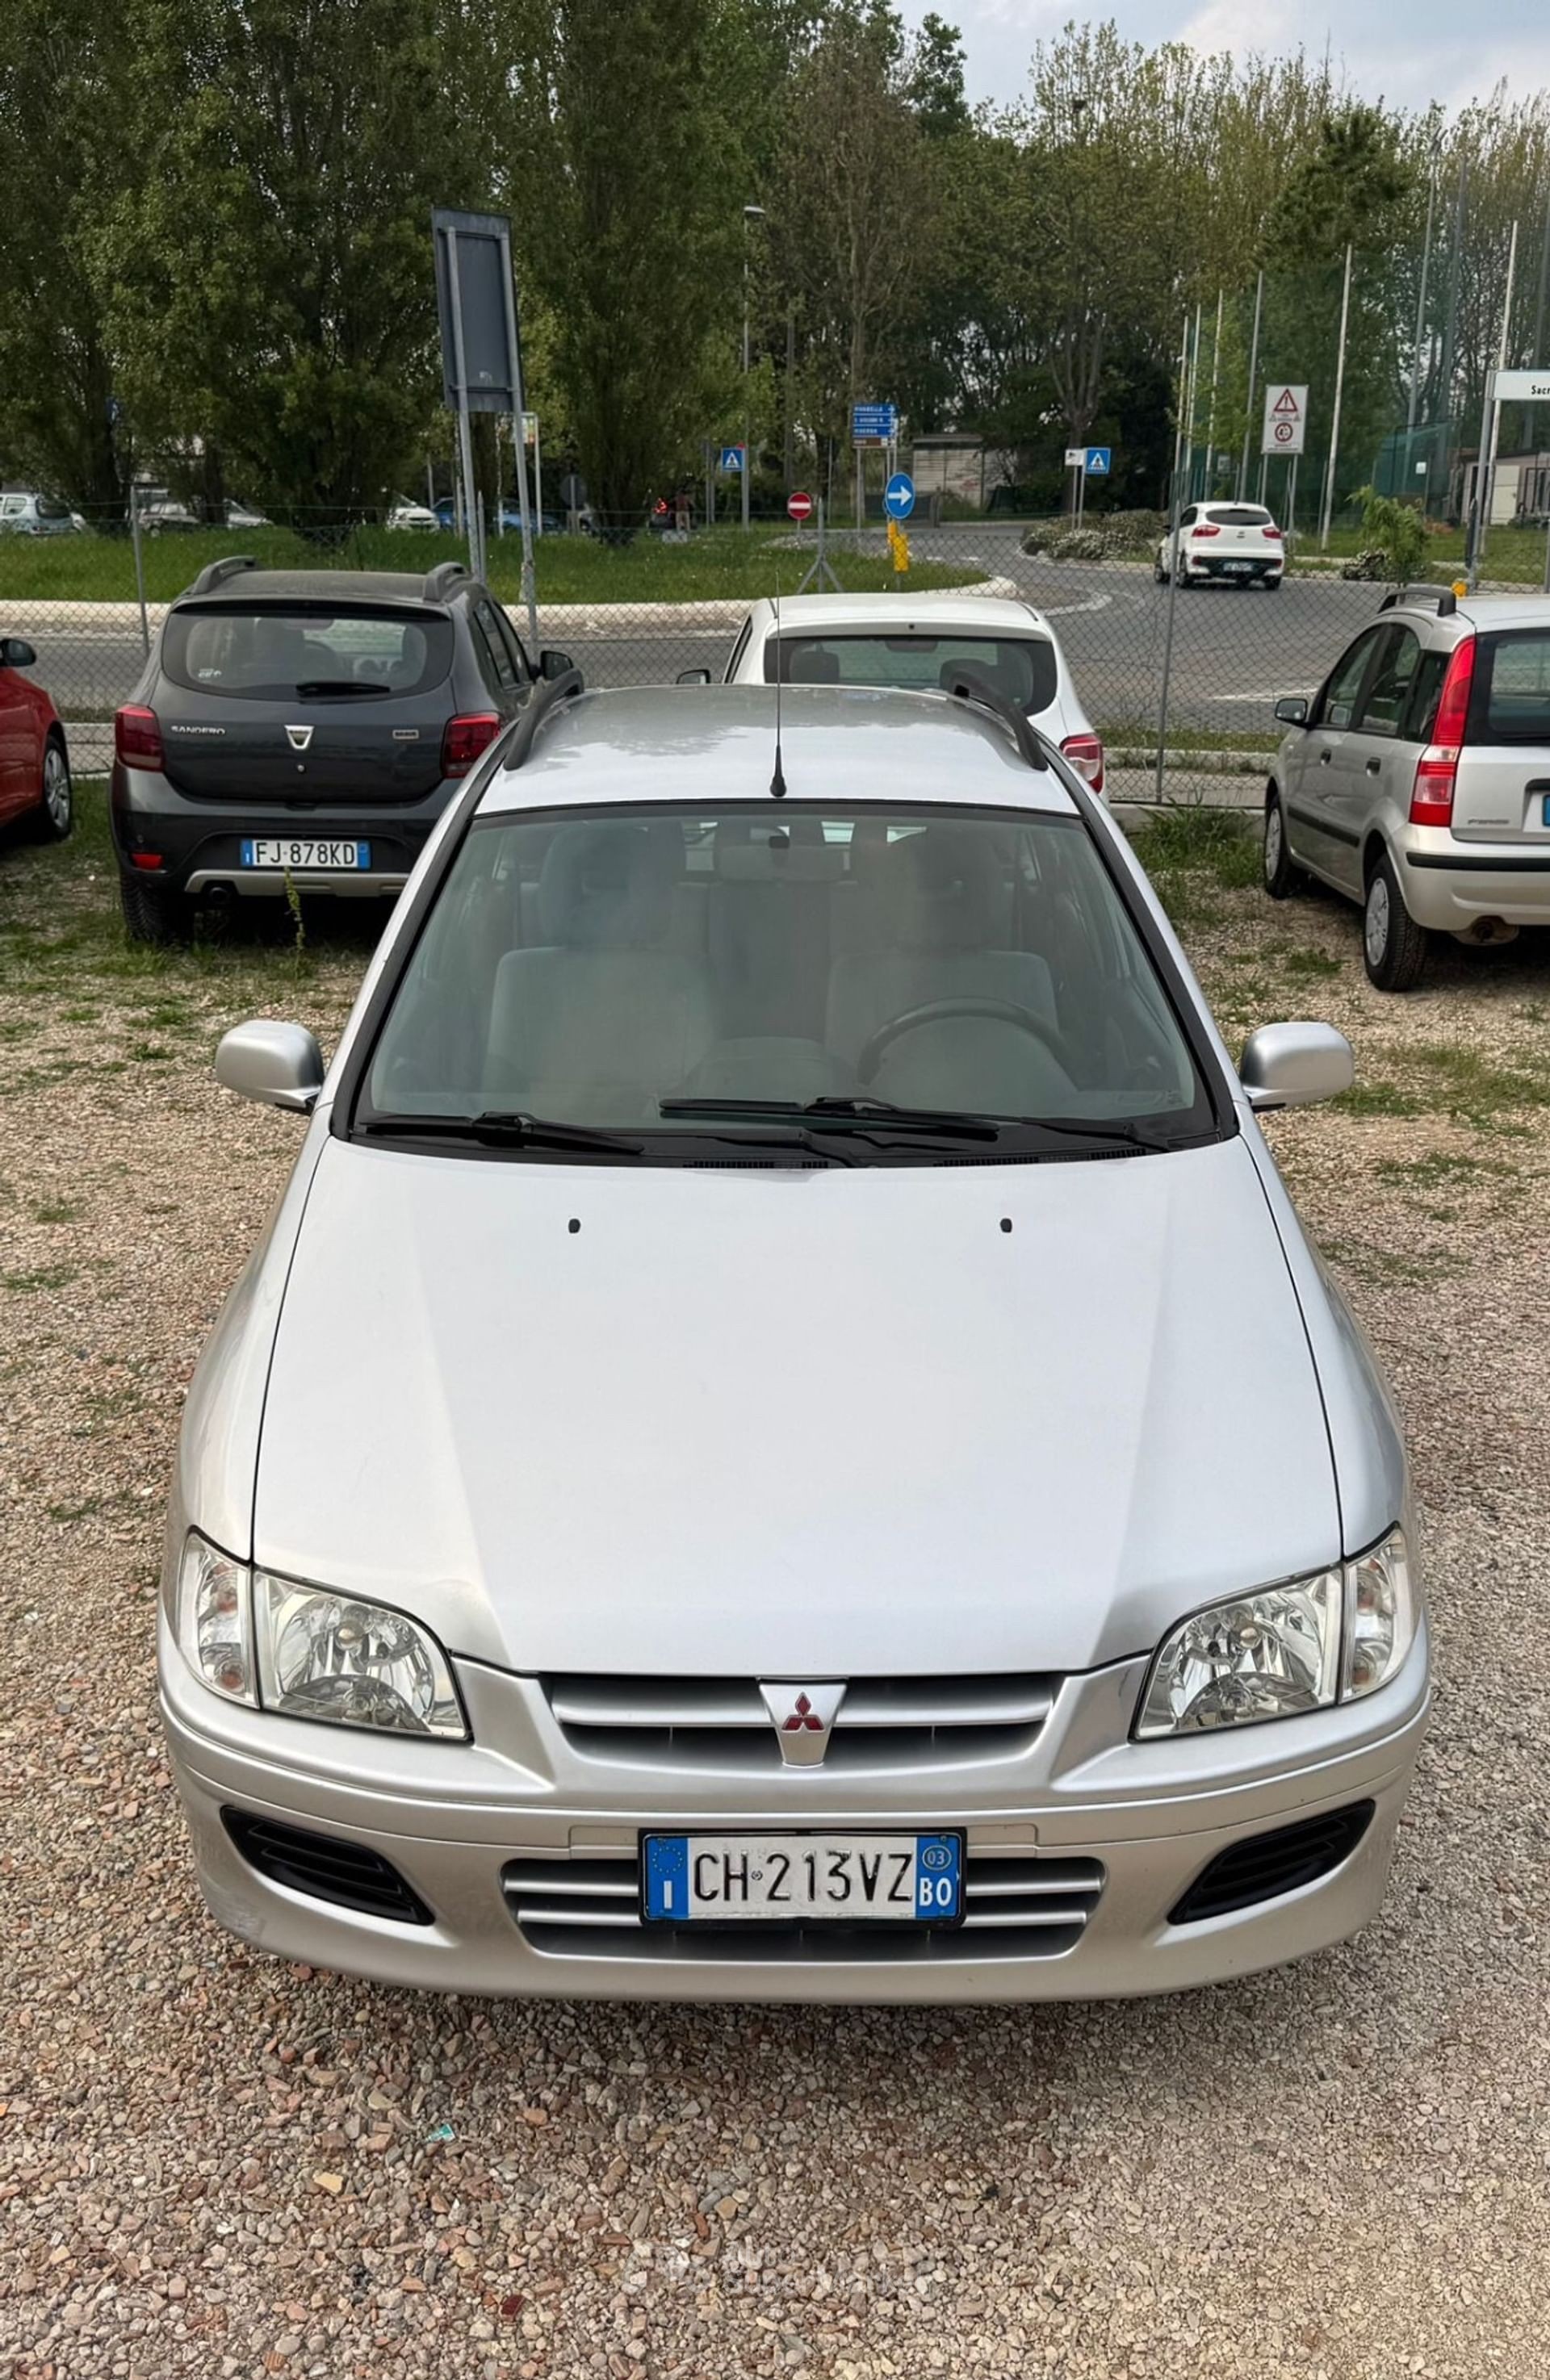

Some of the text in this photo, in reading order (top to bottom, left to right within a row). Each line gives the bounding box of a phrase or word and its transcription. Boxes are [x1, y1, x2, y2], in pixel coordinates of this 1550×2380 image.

[170, 726, 226, 735] SANDERO
[256, 842, 355, 865] FJ 878KD
[927, 1851, 945, 1865] 03
[693, 1850, 914, 1902] CH 213VZ
[919, 1877, 953, 1907] BO
